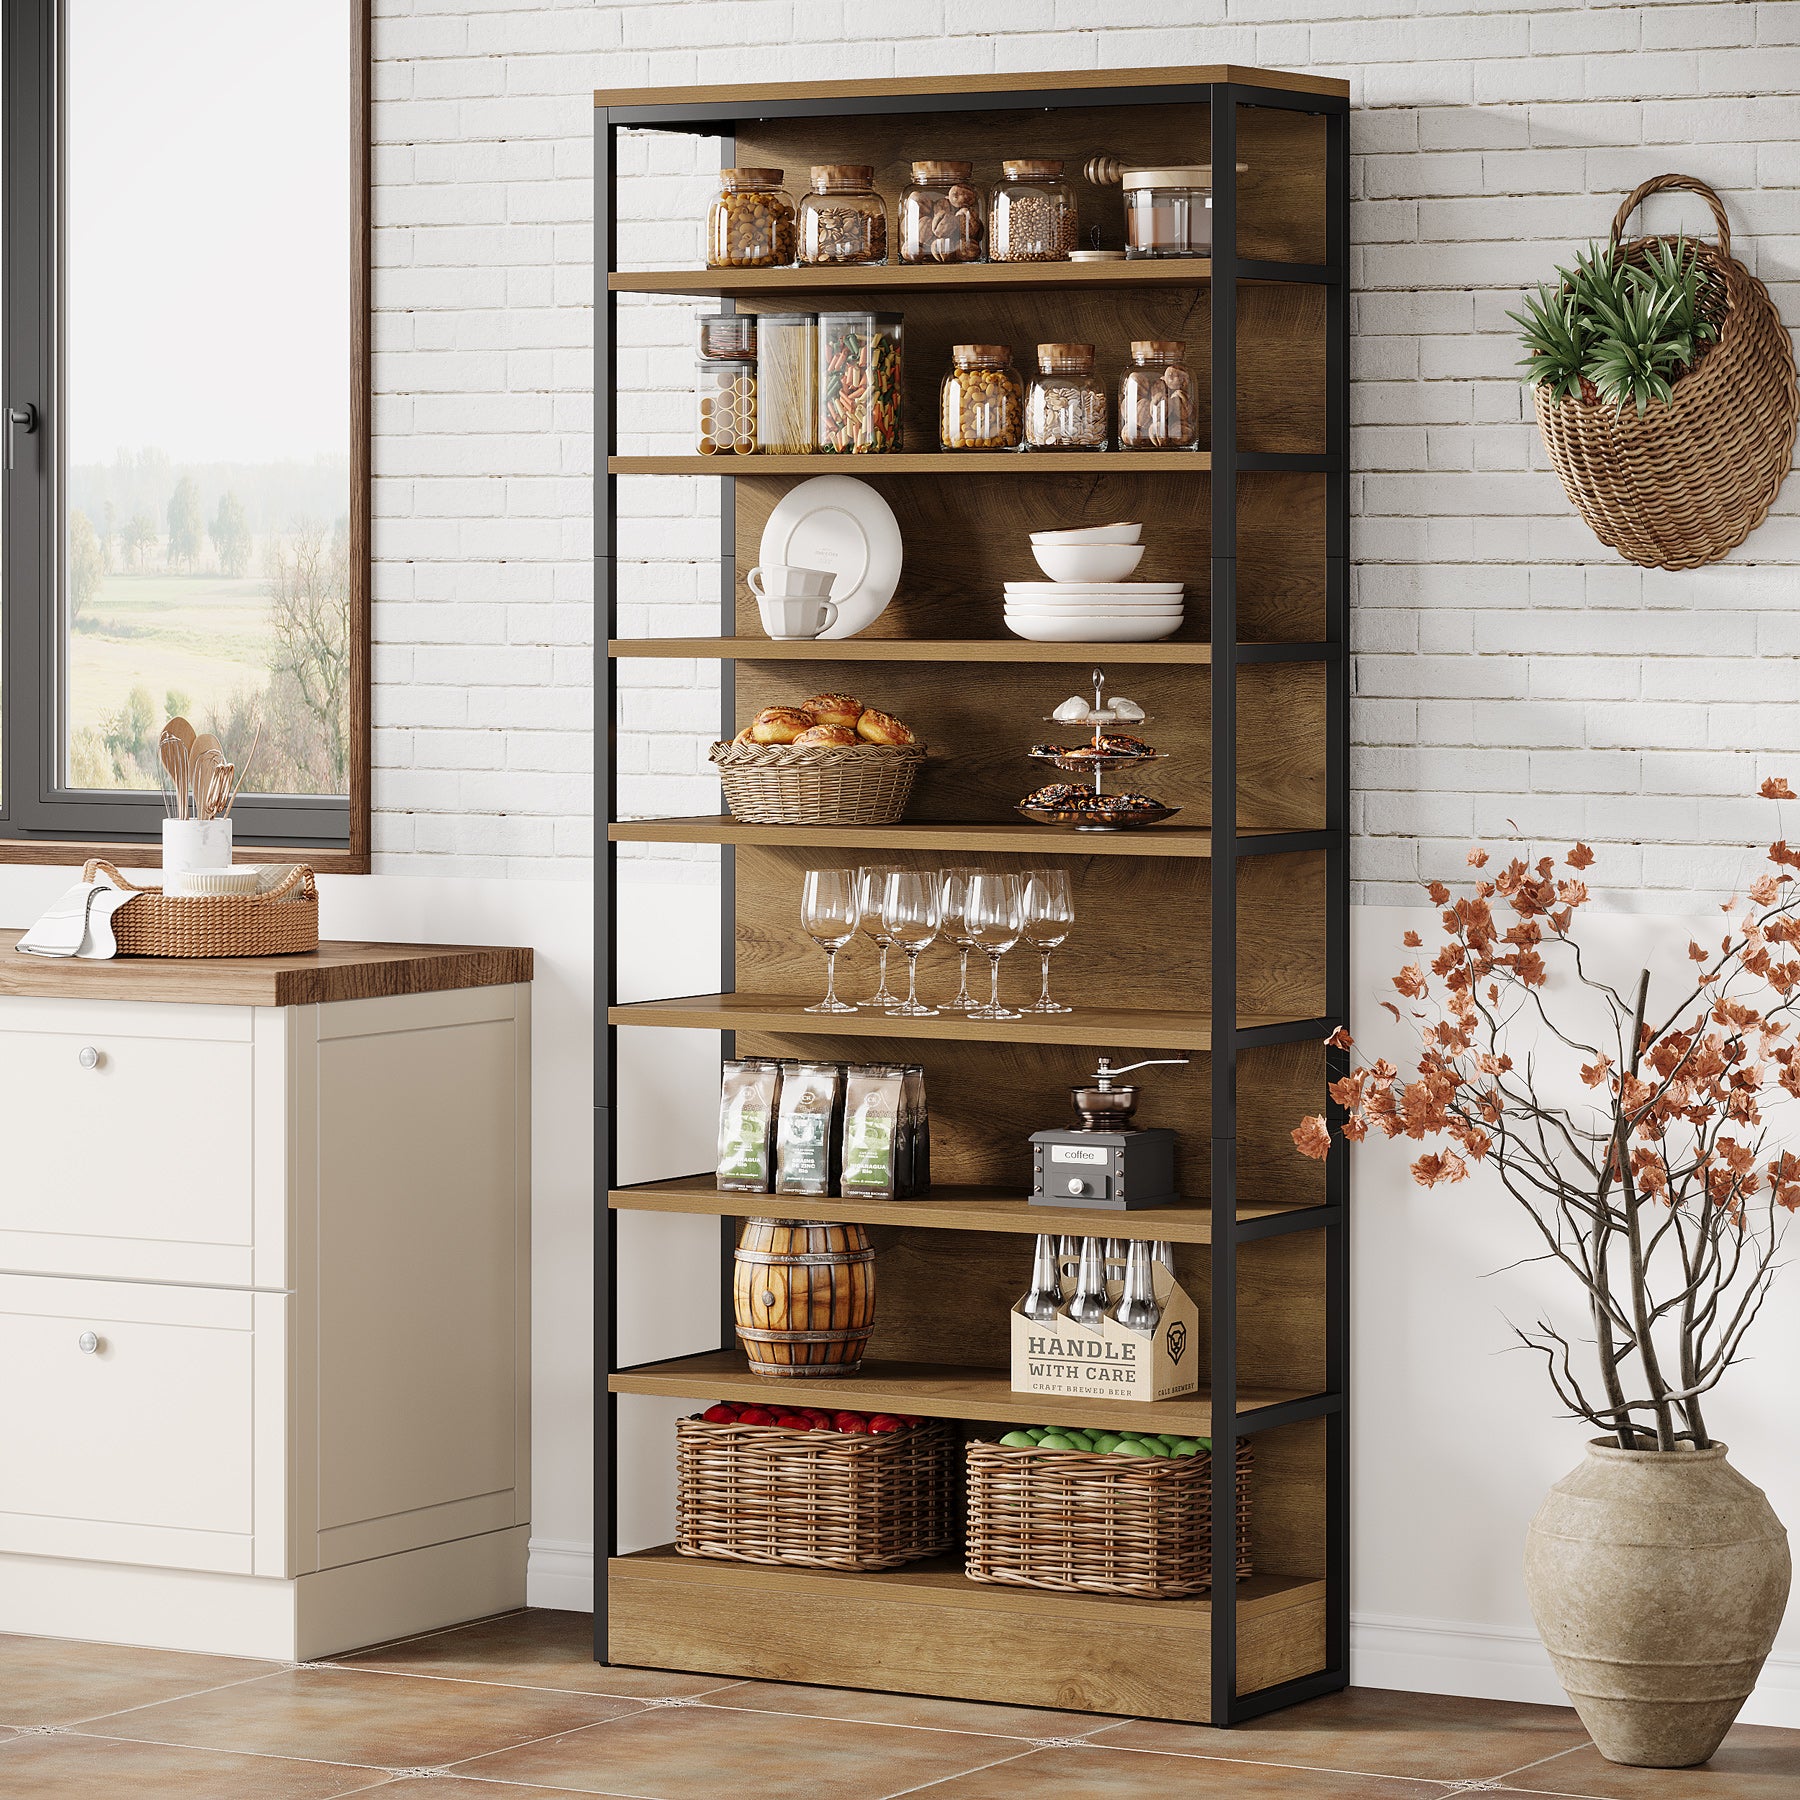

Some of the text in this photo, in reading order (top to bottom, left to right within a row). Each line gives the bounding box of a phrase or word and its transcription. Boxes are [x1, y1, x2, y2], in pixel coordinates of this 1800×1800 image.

[1064, 1150, 1095, 1160] coffee
[1028, 1336, 1136, 1361] HANDLE
[1028, 1363, 1136, 1383] WITH CARE
[1032, 1383, 1132, 1397] CRAFT BREWED BEER
[1171, 1382, 1195, 1394] BREWERY
